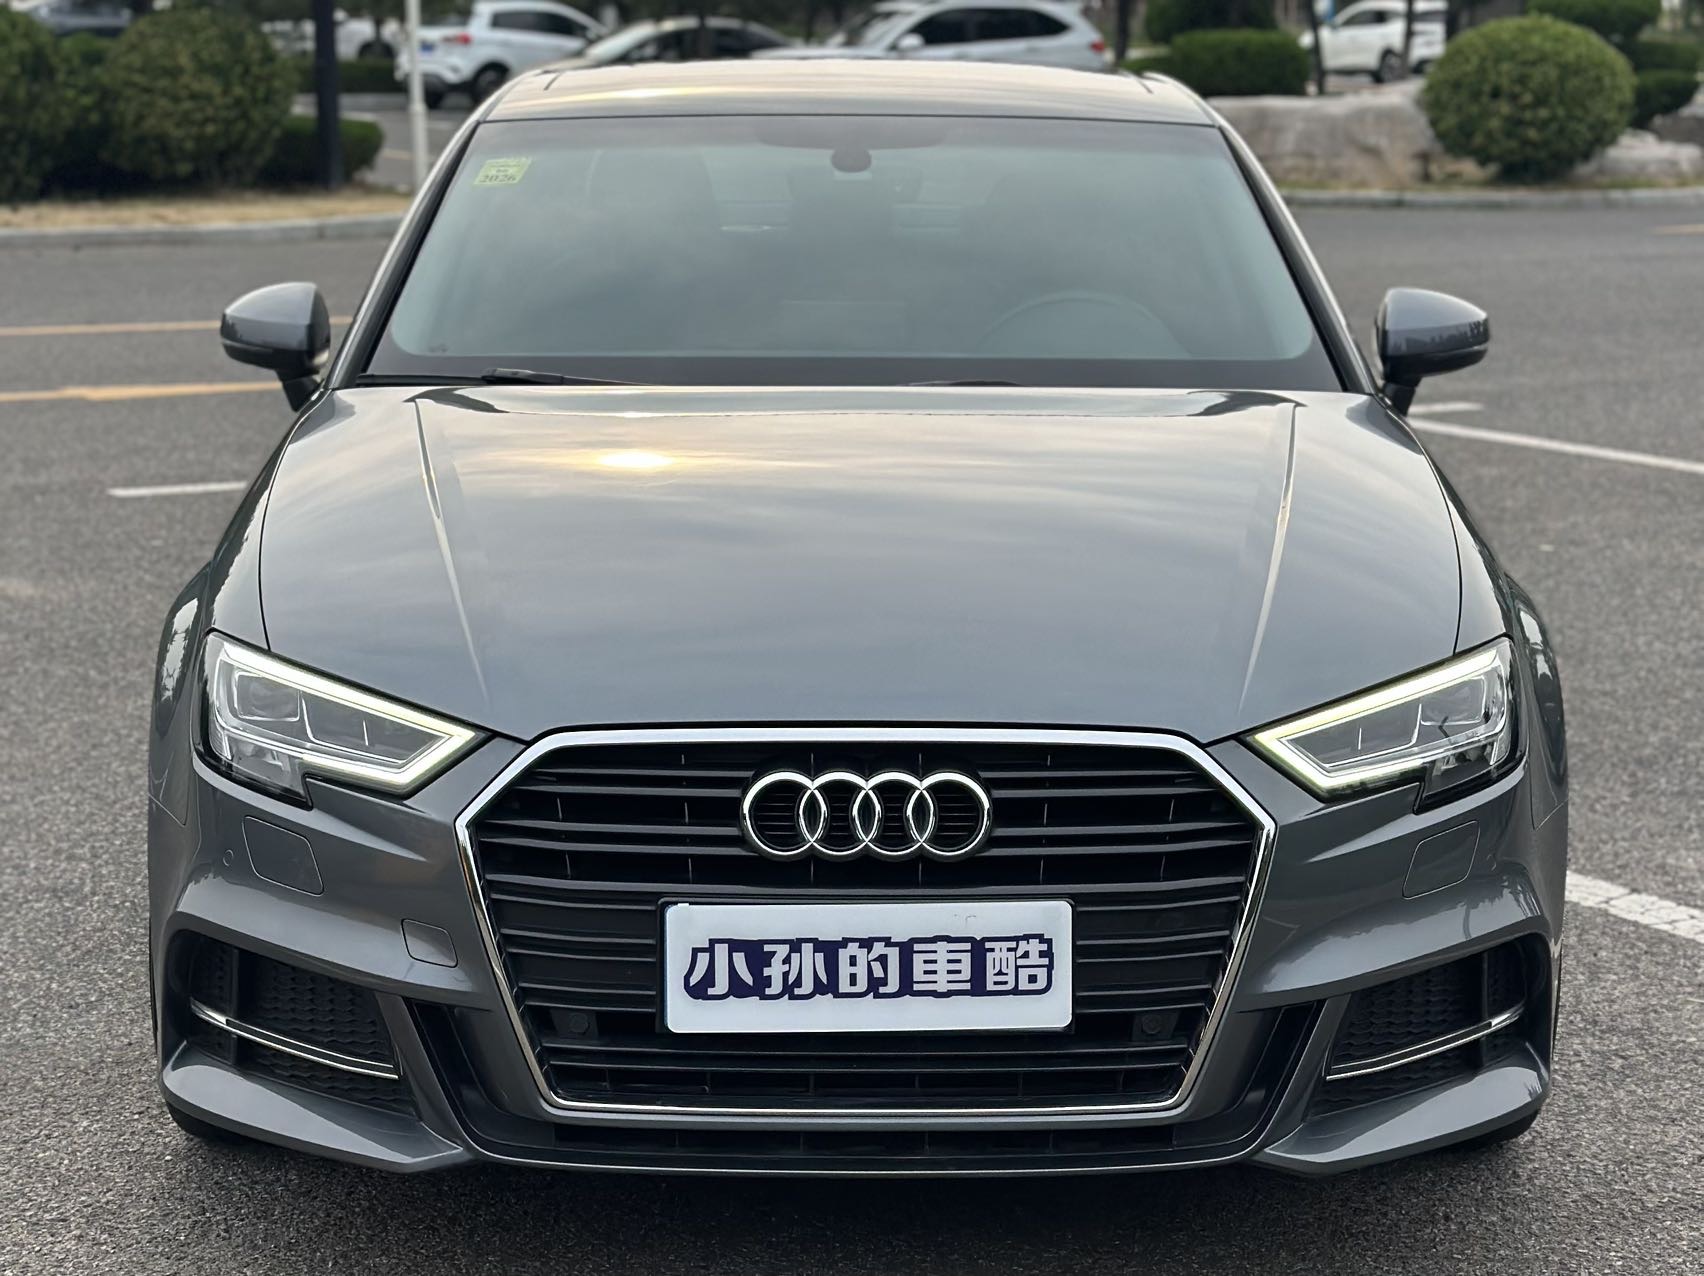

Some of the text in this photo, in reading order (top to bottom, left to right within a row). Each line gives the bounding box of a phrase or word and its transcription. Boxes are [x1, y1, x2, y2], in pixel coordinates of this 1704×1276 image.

[688, 938, 1051, 996] 小孙的車酷
